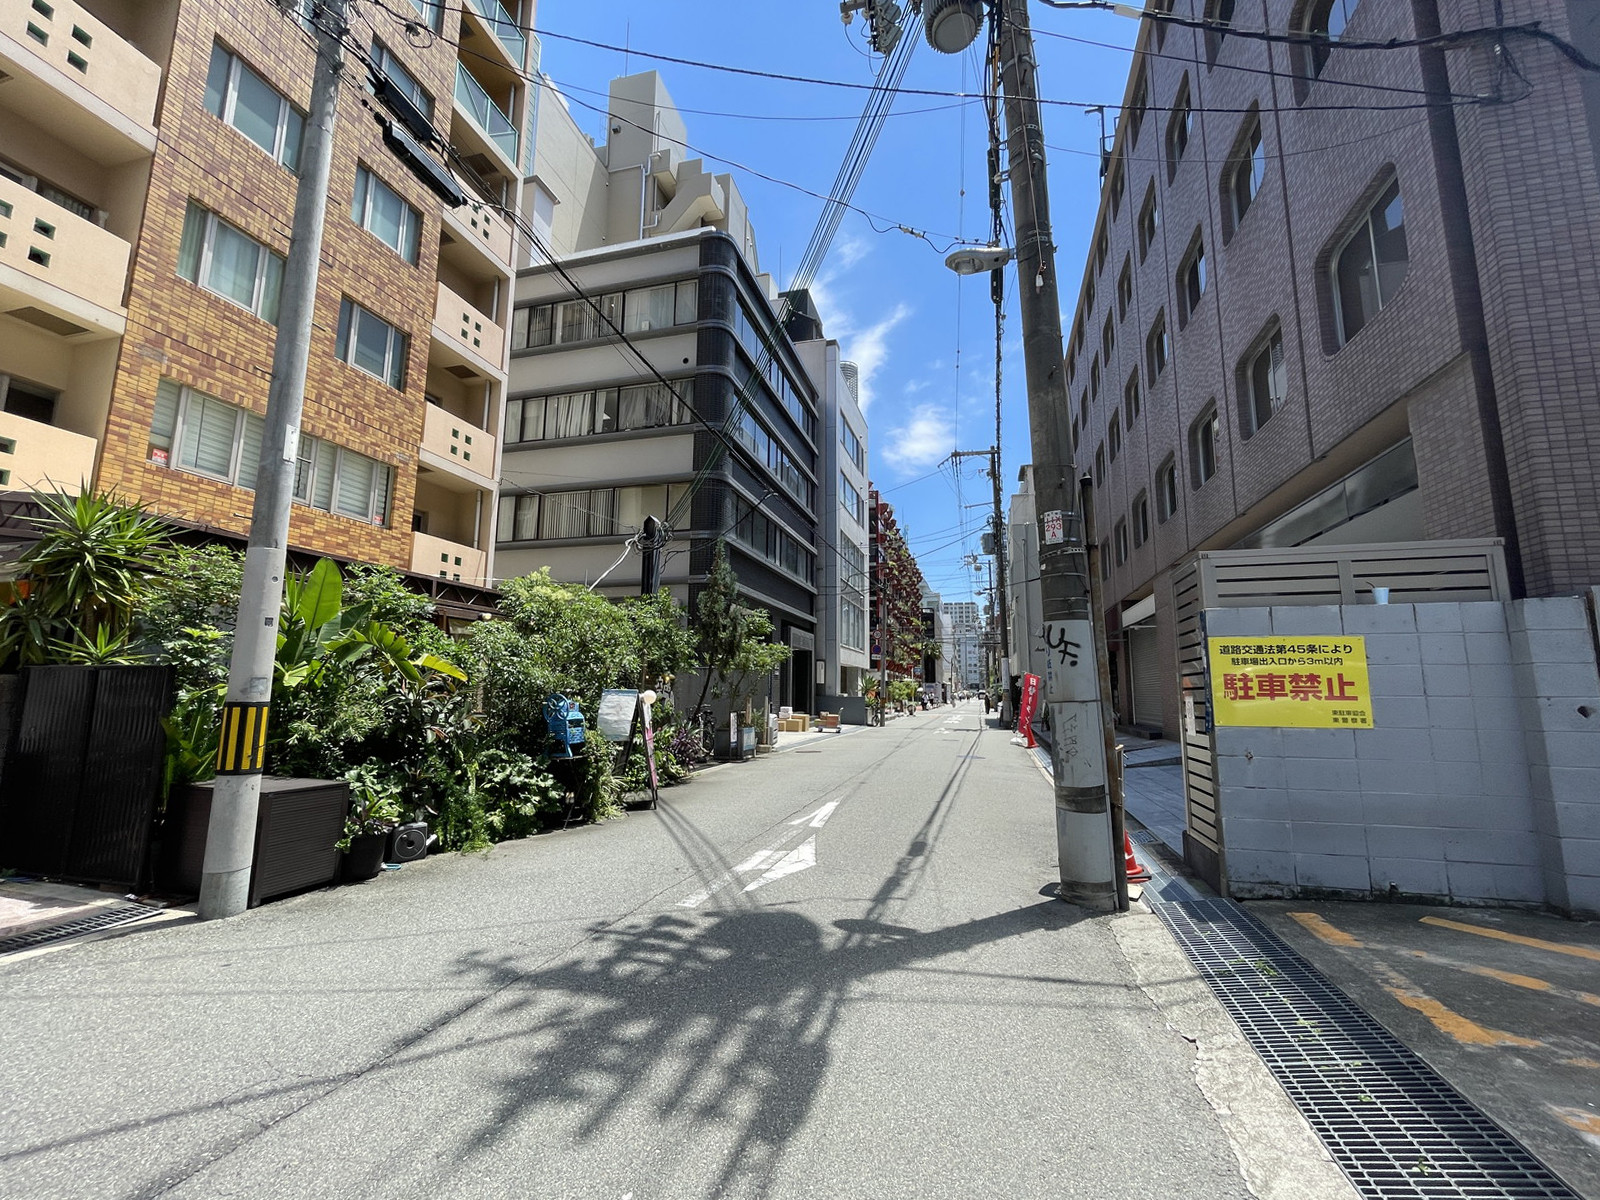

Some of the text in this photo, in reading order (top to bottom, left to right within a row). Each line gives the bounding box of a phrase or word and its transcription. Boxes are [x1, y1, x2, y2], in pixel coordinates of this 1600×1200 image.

[1045, 523, 1062, 532] 293
[1219, 644, 1353, 655] 道路交通法第45条により
[1231, 657, 1344, 666] 駐車場出入口から3m以内
[1223, 673, 1358, 701] 駐車禁止
